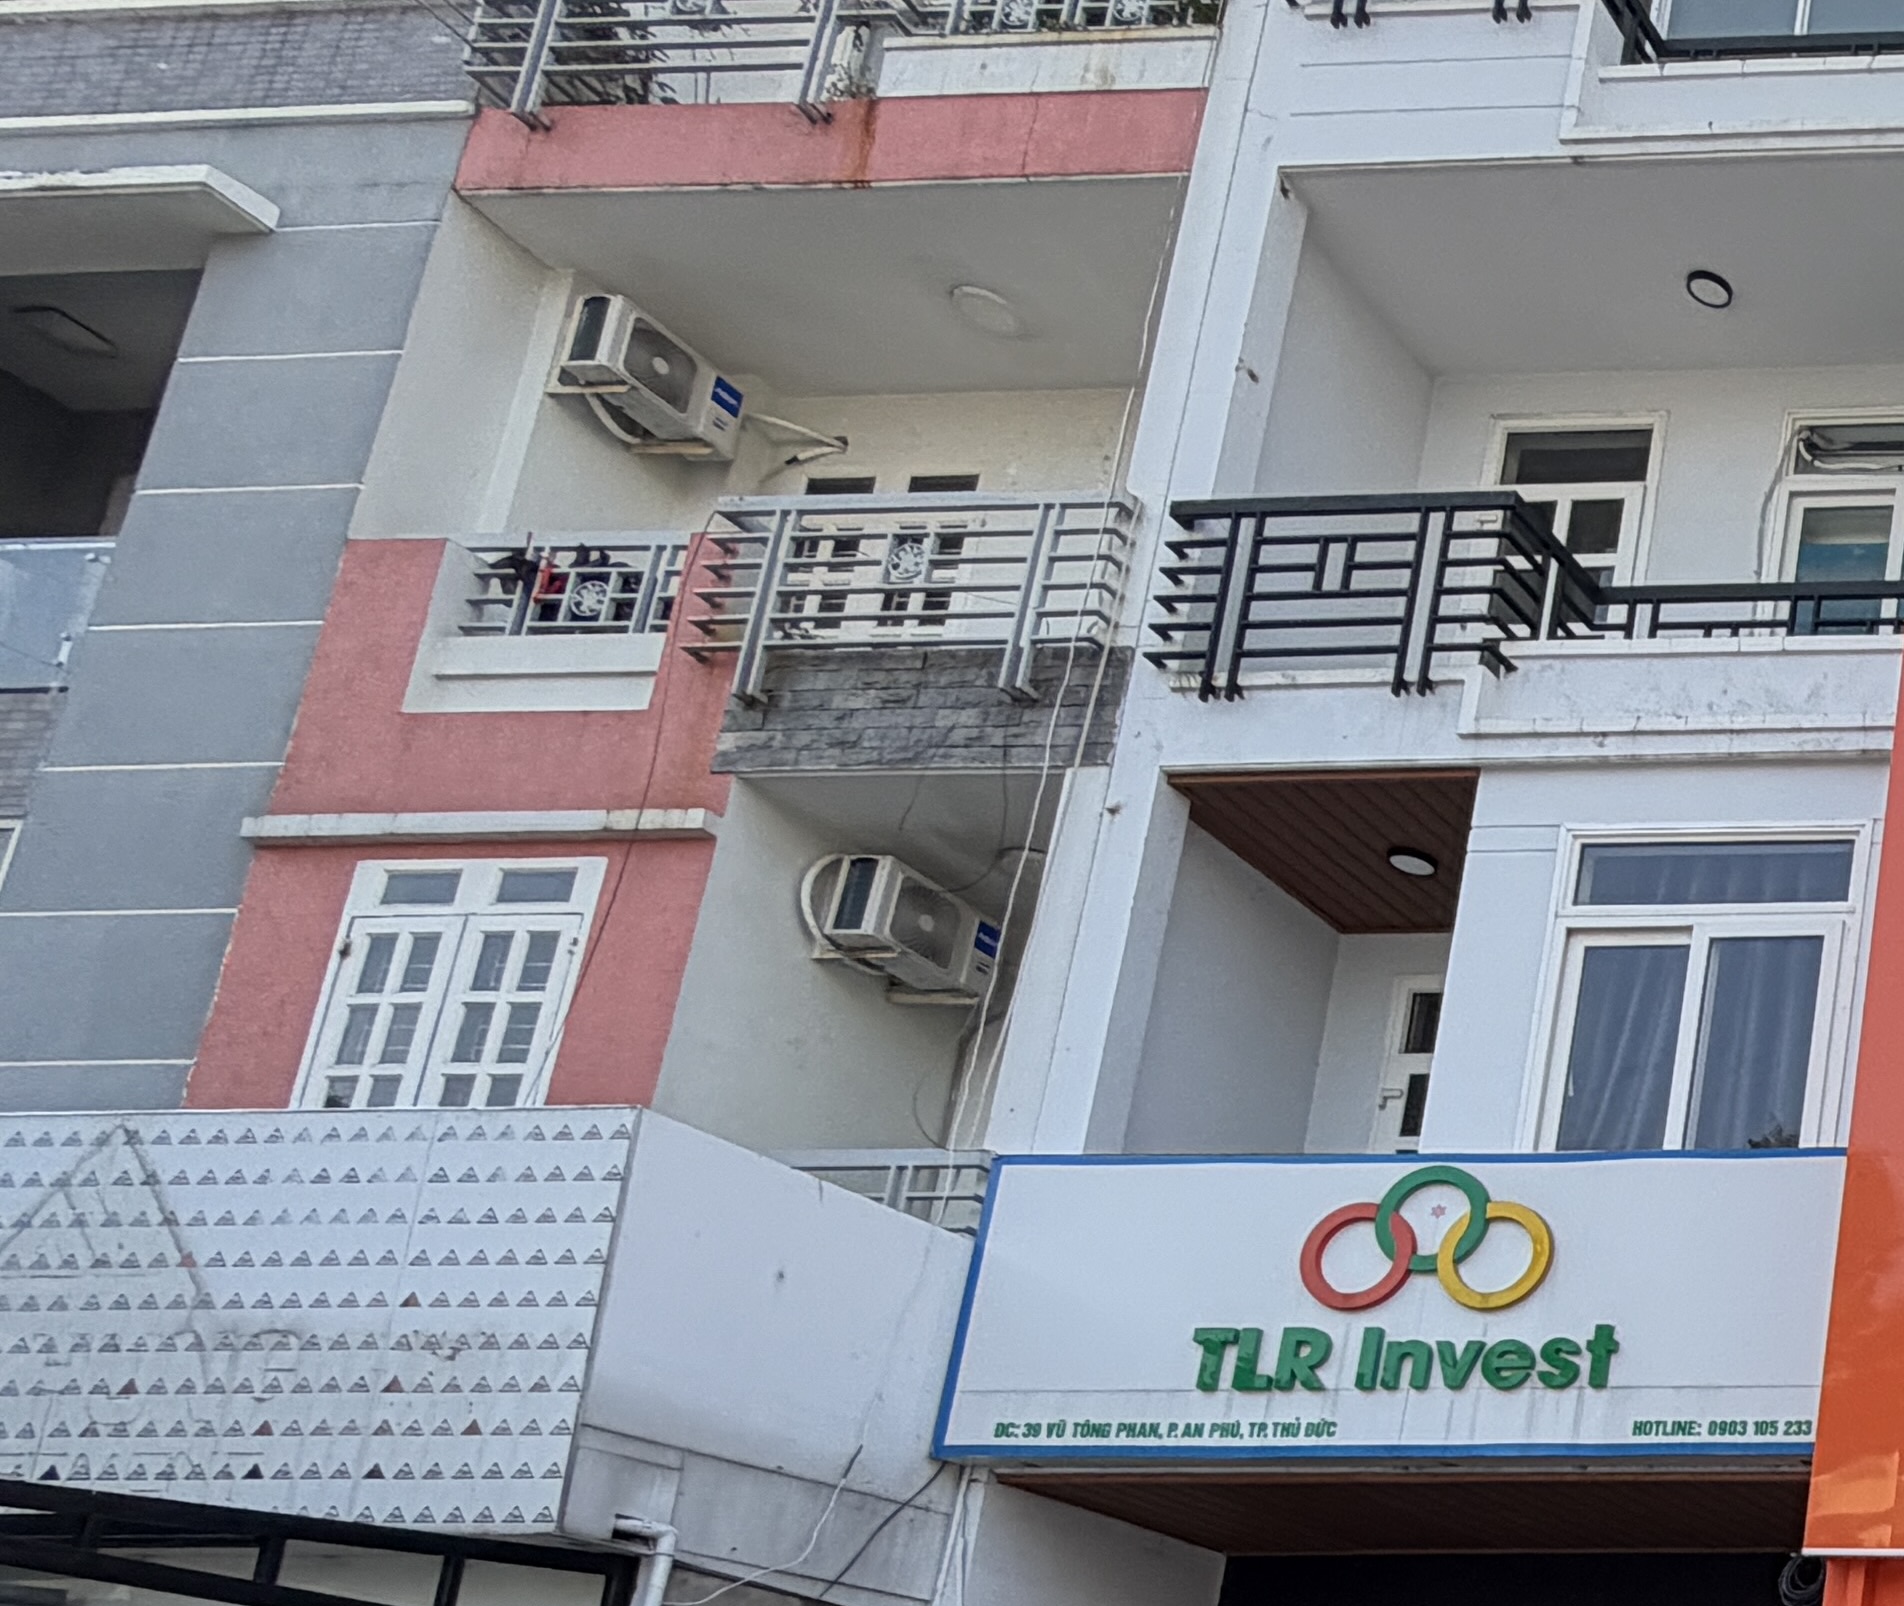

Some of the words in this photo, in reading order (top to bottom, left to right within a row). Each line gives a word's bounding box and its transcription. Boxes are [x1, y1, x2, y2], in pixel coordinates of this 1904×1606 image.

[1192, 1326, 1334, 1393] TLR
[1353, 1323, 1620, 1393] Invest
[1021, 1422, 1042, 1438] 39
[1180, 1422, 1206, 1438] AN
[1631, 1420, 1702, 1437] HOTLINE:
[1706, 1420, 1748, 1437] 0903
[1752, 1420, 1779, 1437] 105
[1782, 1420, 1813, 1437] 233
